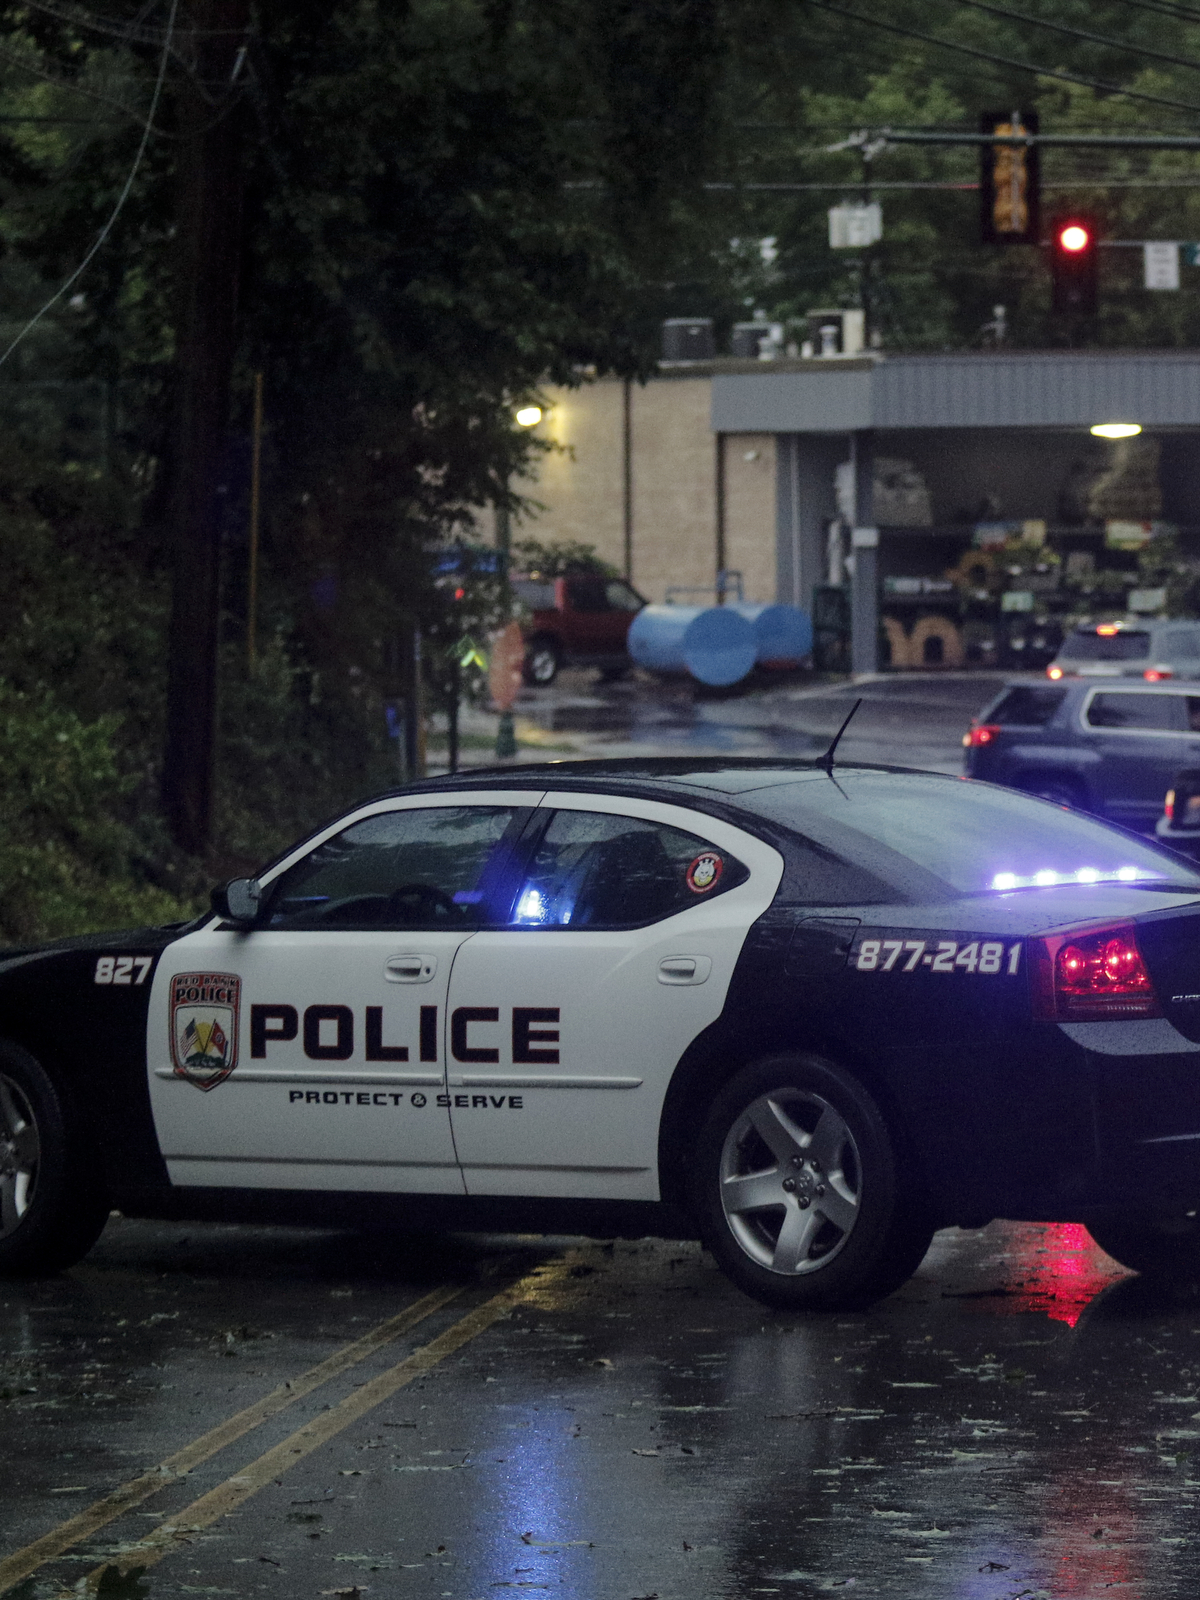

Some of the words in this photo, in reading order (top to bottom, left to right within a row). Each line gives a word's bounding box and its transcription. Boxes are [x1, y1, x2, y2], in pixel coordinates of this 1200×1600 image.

[94, 956, 153, 985] 827
[856, 940, 1022, 975] 877-2481
[175, 987, 236, 1003] POLICE
[250, 1004, 560, 1064] POLICE
[289, 1090, 403, 1107] PROTECT
[436, 1094, 524, 1109] SERVE
